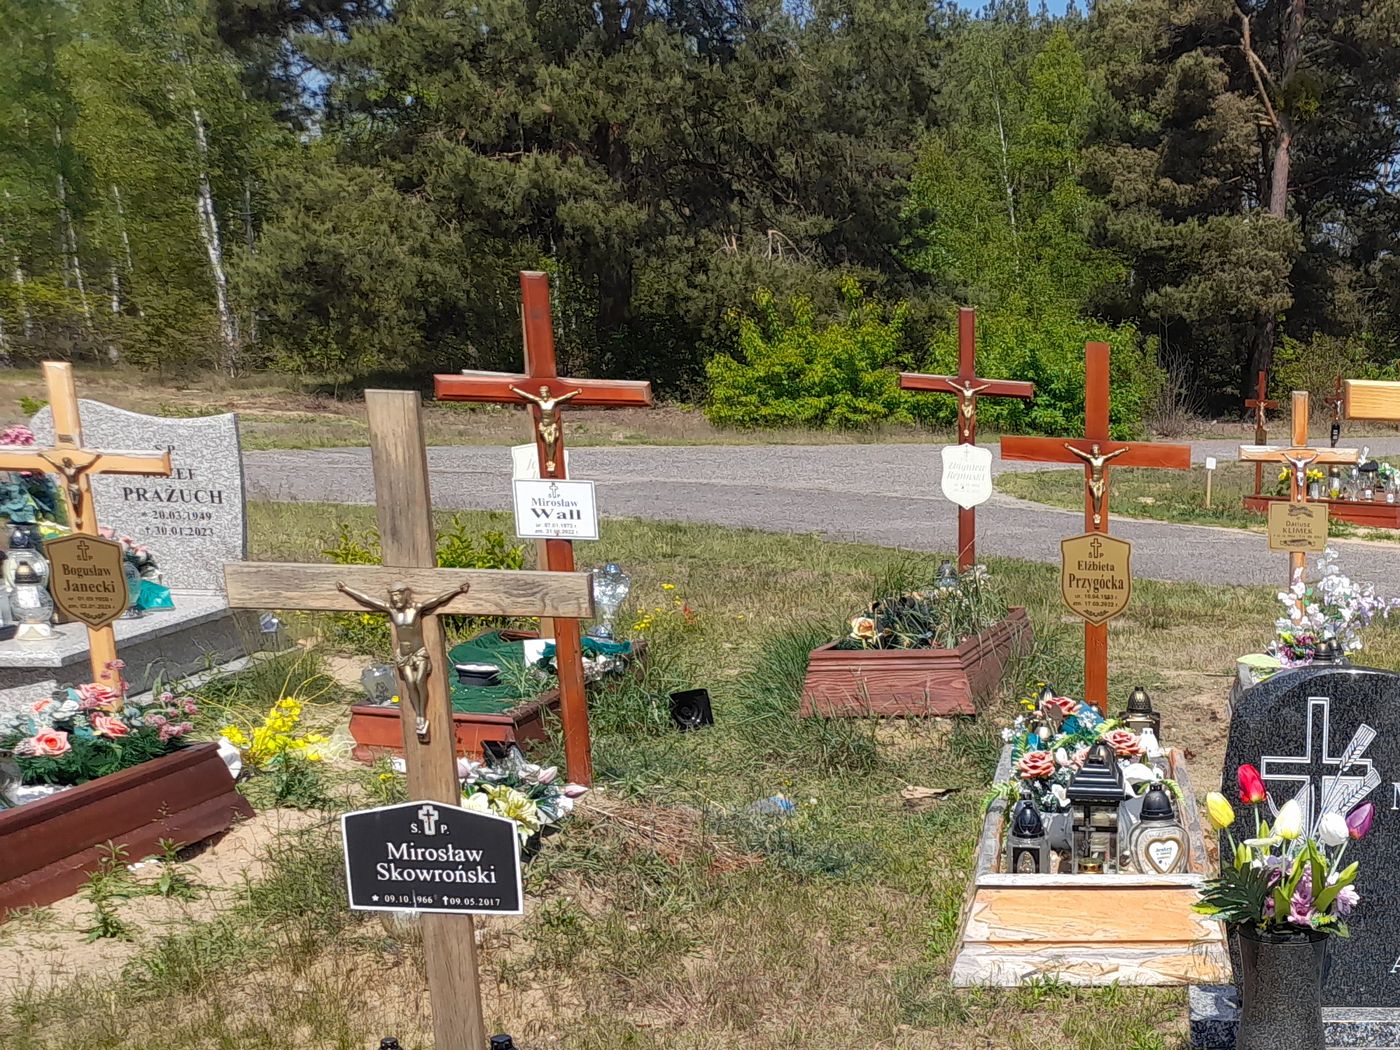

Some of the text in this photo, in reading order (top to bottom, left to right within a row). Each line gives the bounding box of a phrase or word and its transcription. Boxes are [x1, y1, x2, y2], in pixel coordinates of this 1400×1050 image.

[123, 485, 223, 504] PRAŻUCH
[531, 508, 581, 520] Wall
[1078, 560, 1115, 572] Elżbieta
[64, 579, 116, 593] Janecki
[1069, 573, 1124, 593] Przygócka
[386, 843, 483, 862] Mirosław
[376, 862, 497, 884] Skowroński
[450, 897, 501, 906] 09.05.2017
